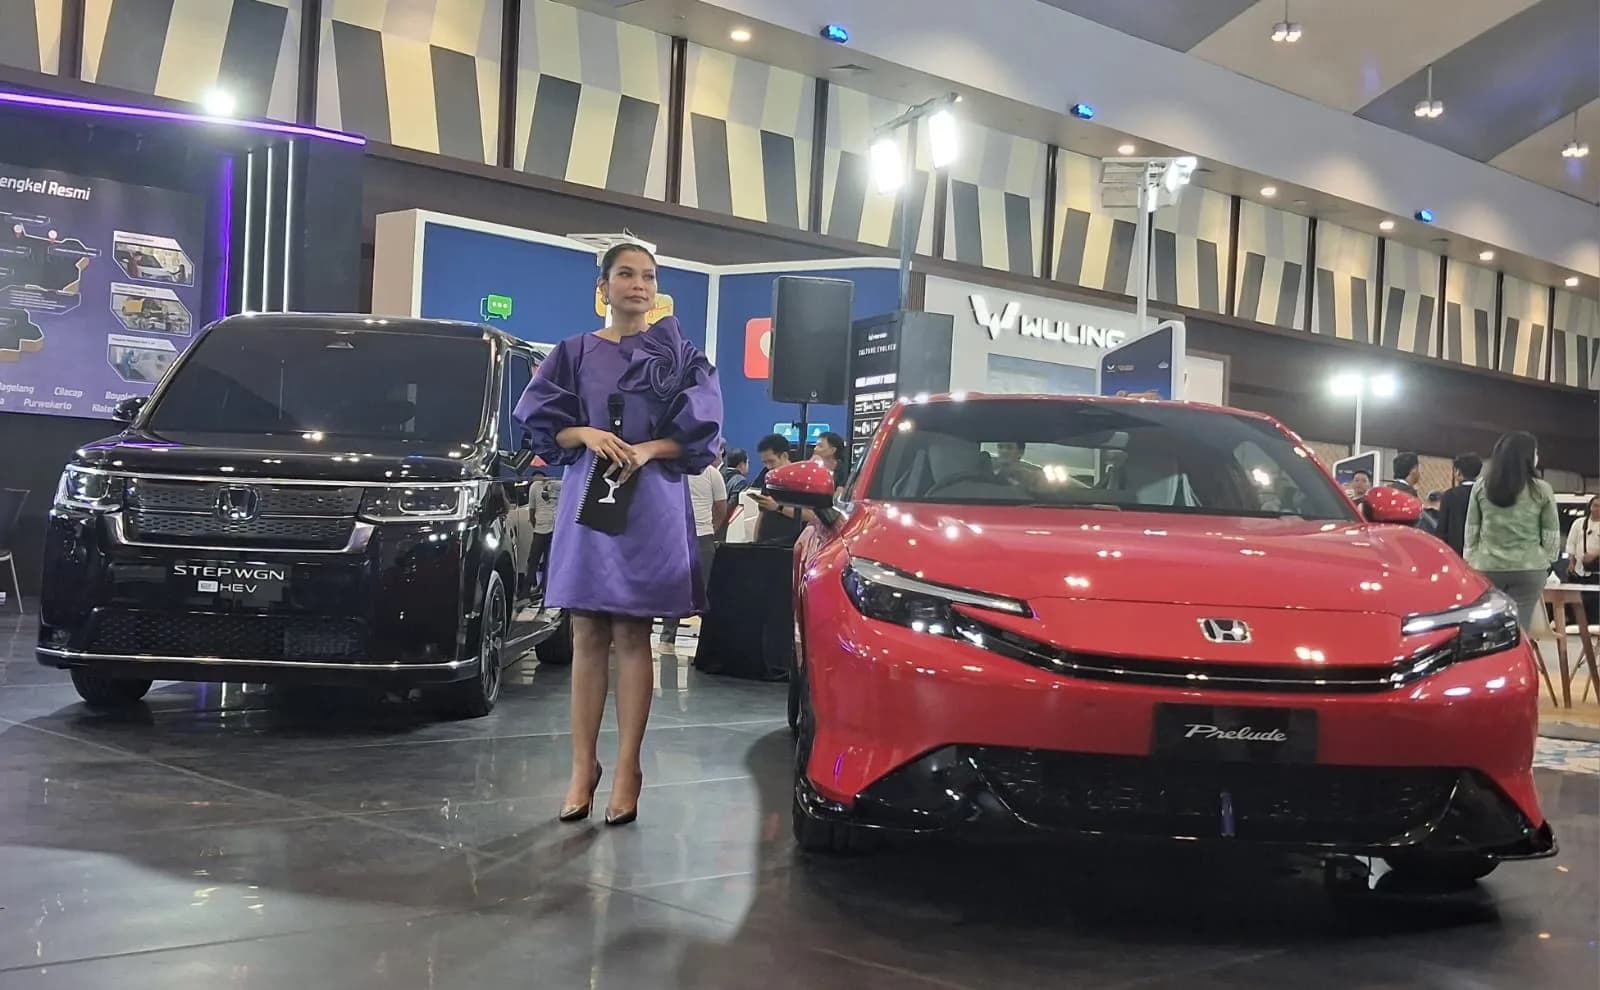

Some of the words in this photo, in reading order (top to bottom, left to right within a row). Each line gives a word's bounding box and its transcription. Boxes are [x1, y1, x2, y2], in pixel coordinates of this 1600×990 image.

[47, 181, 92, 200] Resmi
[1019, 315, 1126, 348] WULING
[54, 387, 83, 398] Cilacap
[1184, 724, 1287, 742] Prelude
